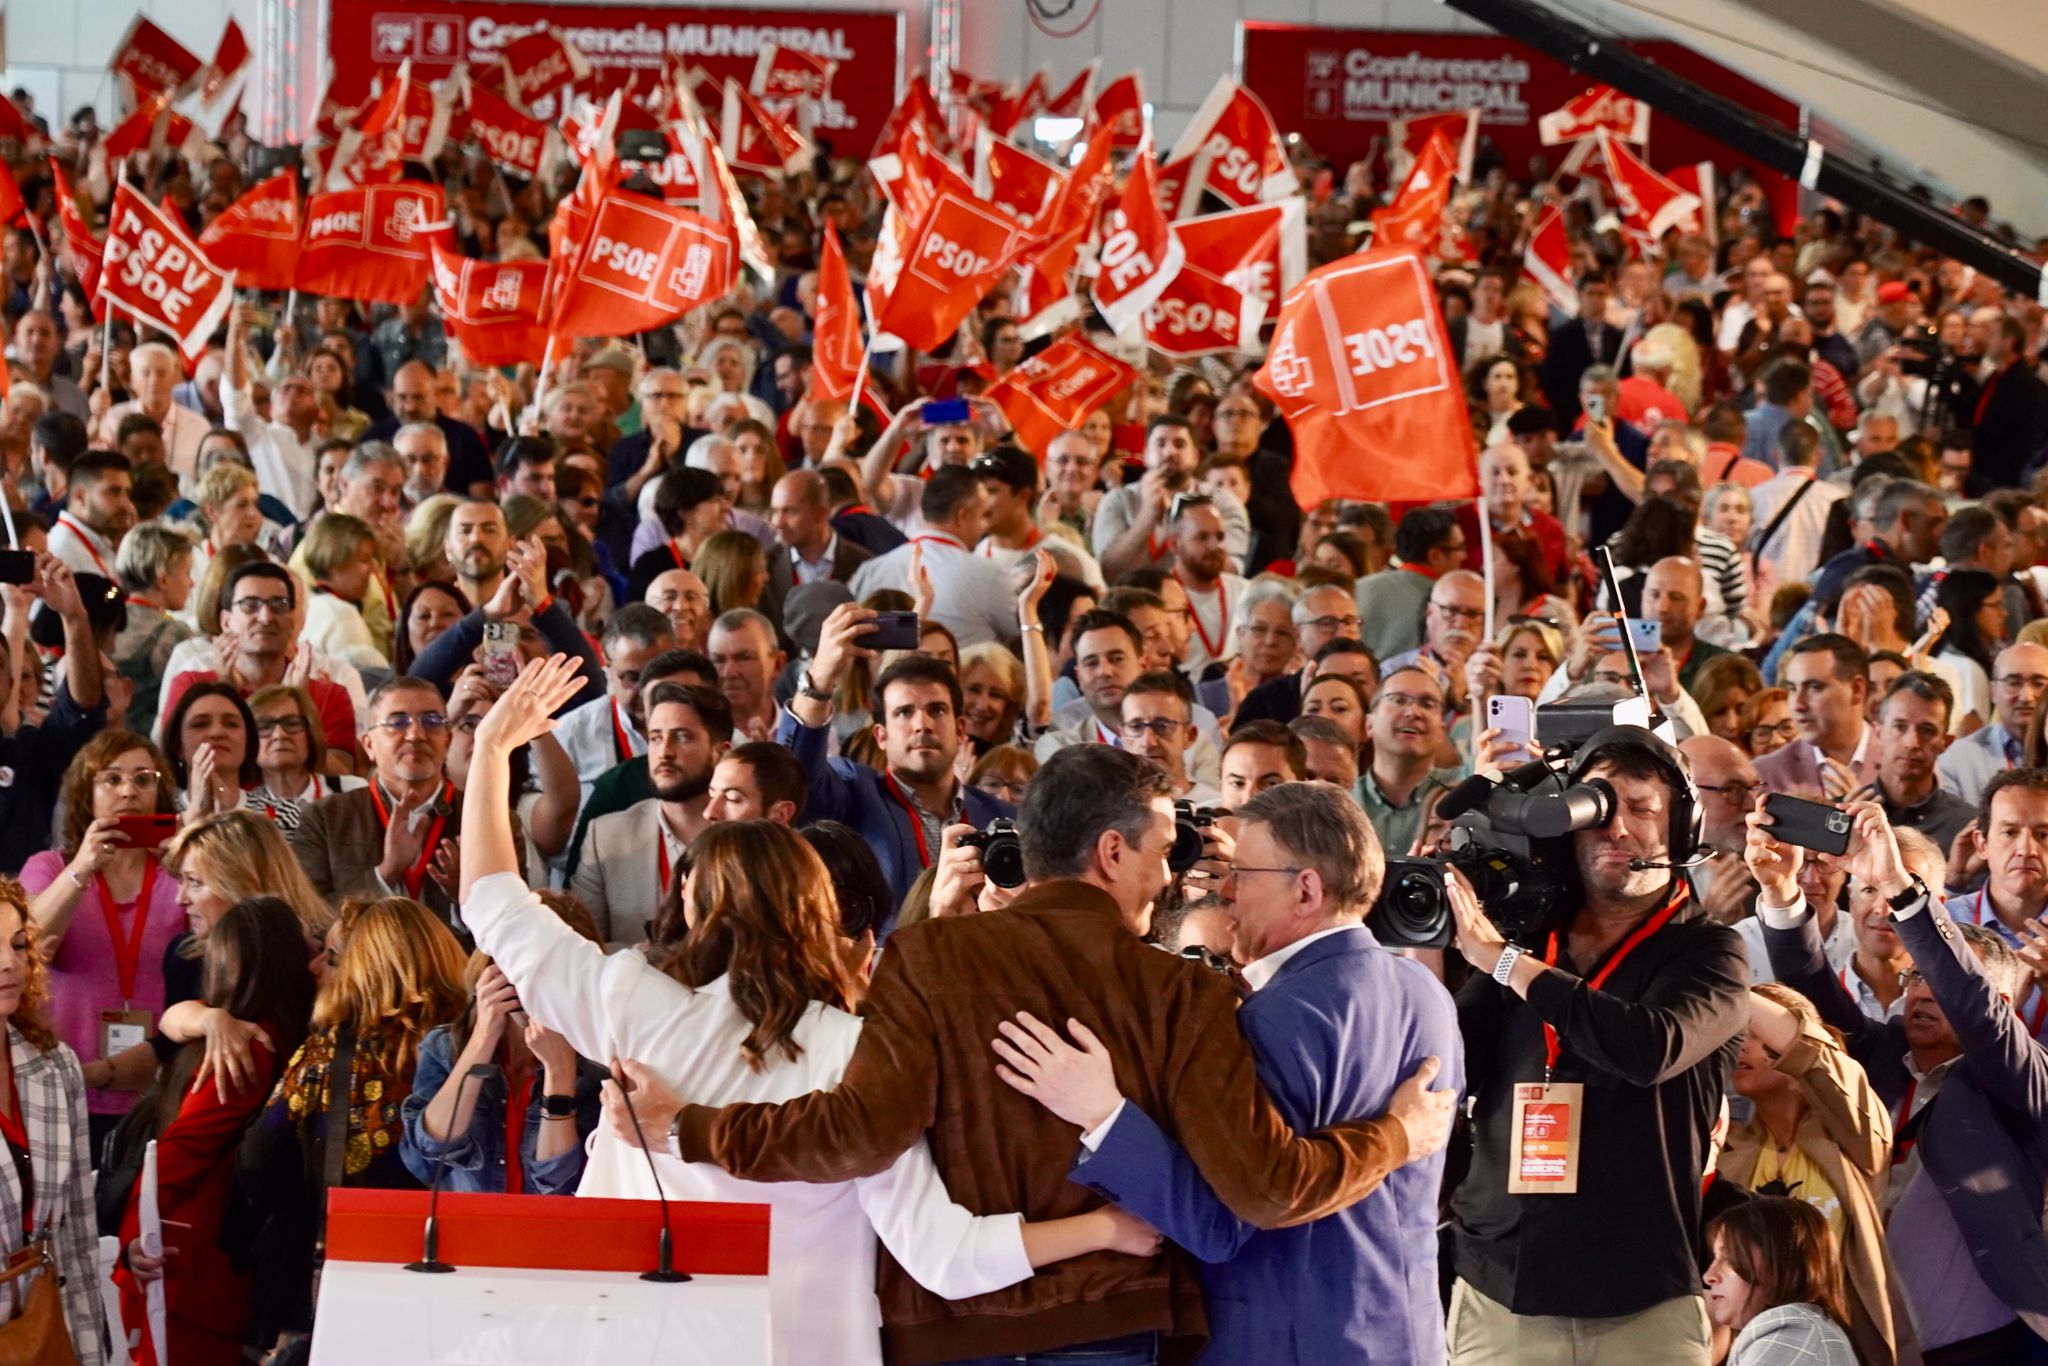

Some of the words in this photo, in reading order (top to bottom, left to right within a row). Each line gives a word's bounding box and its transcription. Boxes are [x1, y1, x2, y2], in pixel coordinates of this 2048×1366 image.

[1345, 48, 1530, 82] Conferencia
[1344, 81, 1530, 109] MUNICIPAL
[310, 211, 363, 239] PSOE
[591, 236, 658, 282] PSOE
[103, 233, 193, 325] PSOE
[1145, 297, 1237, 342] PSOE
